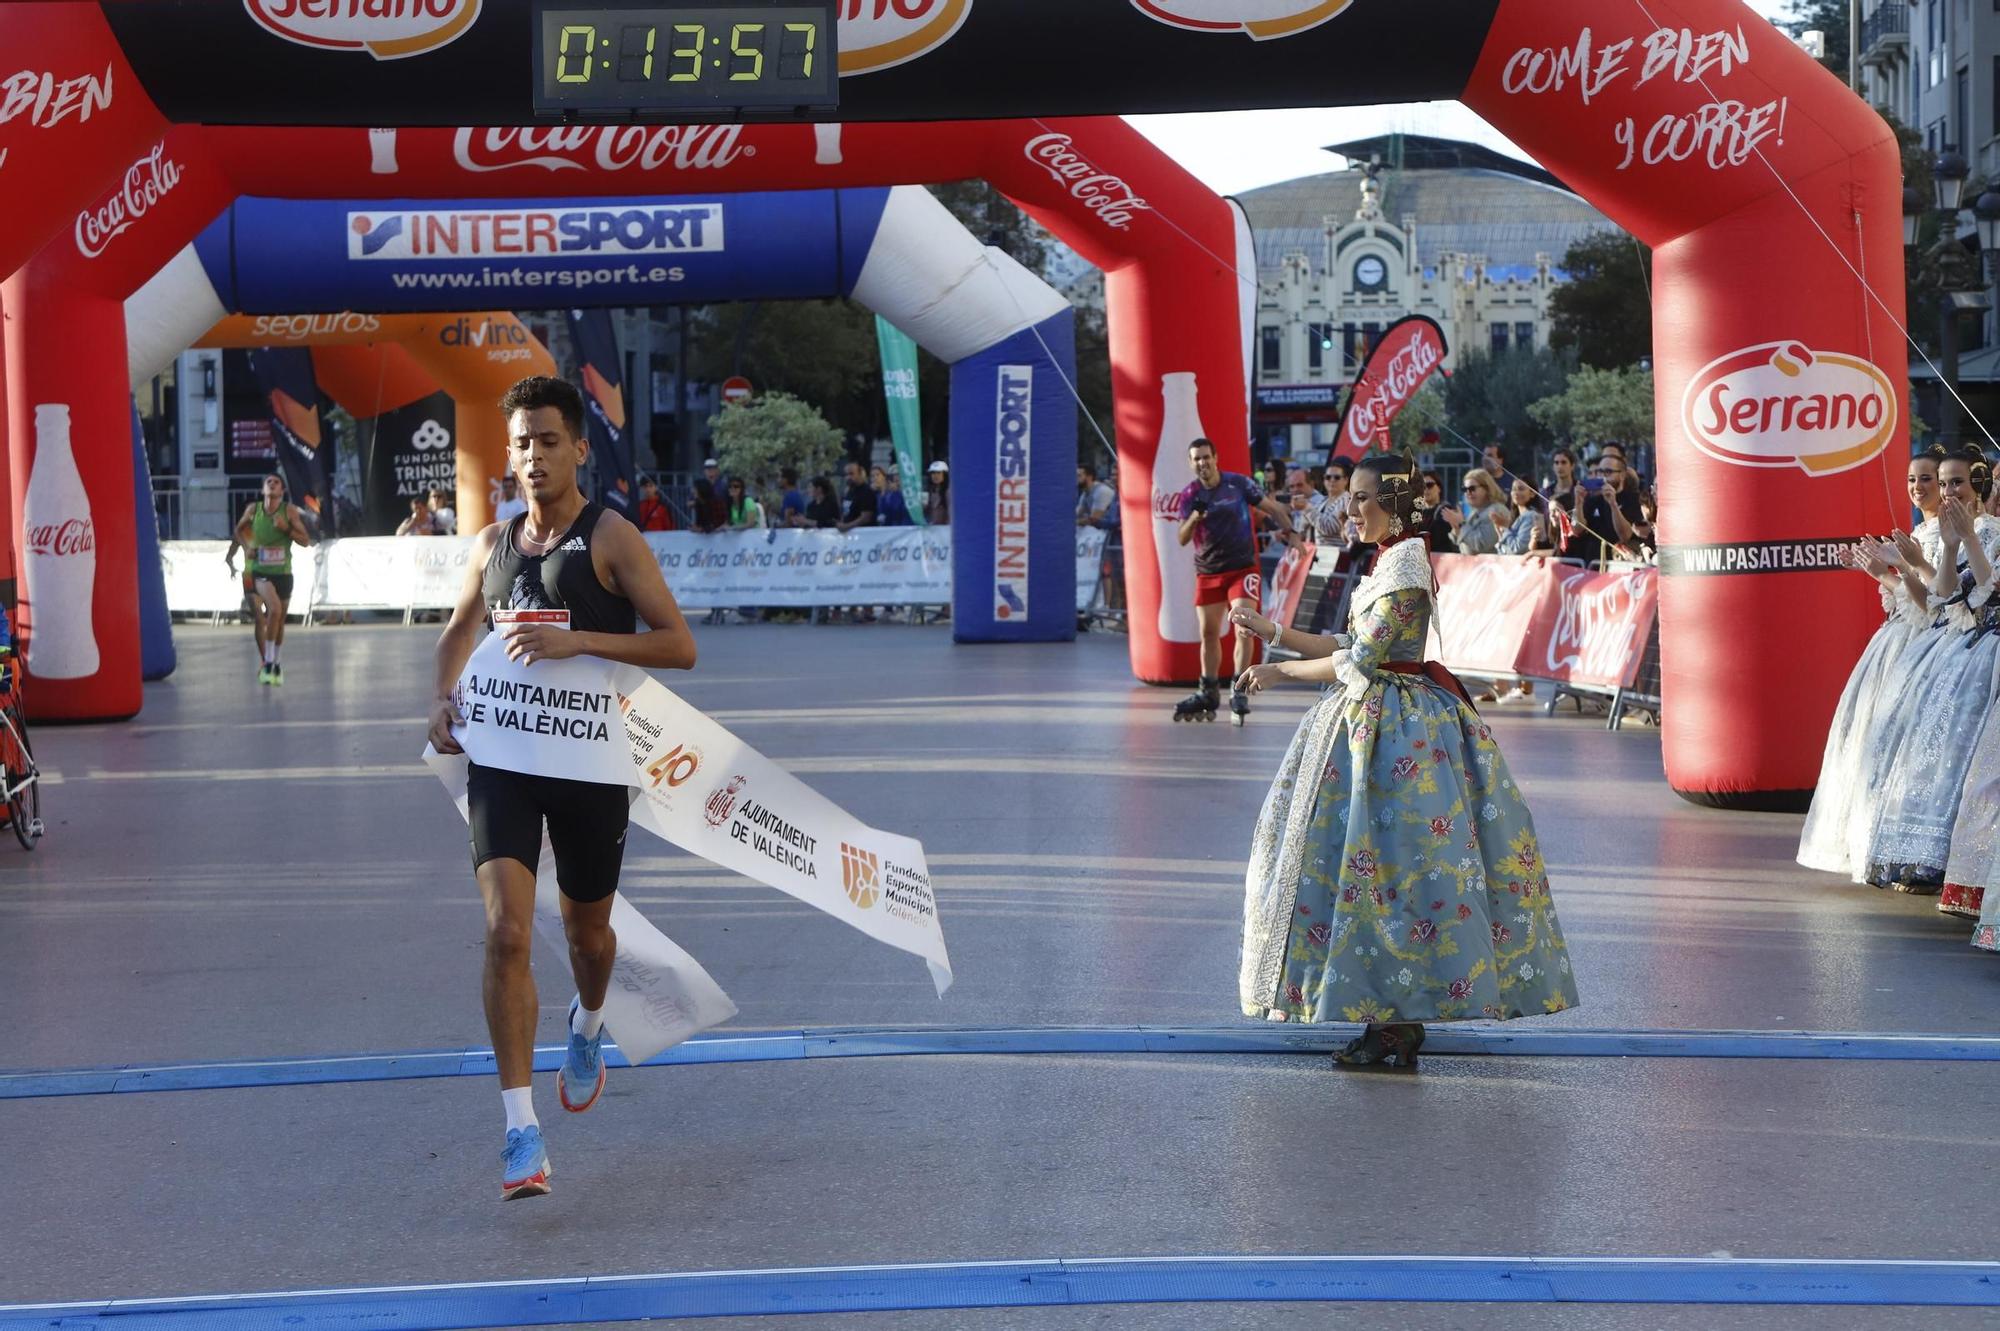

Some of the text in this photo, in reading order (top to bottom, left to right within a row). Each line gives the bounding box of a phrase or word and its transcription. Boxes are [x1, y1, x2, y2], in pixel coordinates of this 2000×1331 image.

[556, 24, 816, 82] 0:13:57
[1502, 22, 1750, 105] COME BIEN
[0, 61, 113, 128] BIEN
[453, 126, 744, 172] CocaCola
[1642, 97, 1788, 170] CORRE!
[75, 139, 180, 258] Coca-Cola
[1024, 133, 1152, 228] Coca-Cola
[412, 208, 711, 255] INTERSPORT
[392, 264, 686, 288] www.intersport.es
[252, 312, 381, 339] seguros
[440, 317, 528, 347] divina
[1703, 383, 1883, 436] Serrano
[997, 374, 1029, 579] INTERSPORT
[467, 674, 612, 714] AJUNTAMENT
[494, 707, 610, 742] VALÈNCIA
[626, 708, 664, 739] Fundació
[646, 743, 699, 787] 40
[731, 820, 817, 879] DE VALÈNCIA
[739, 799, 817, 855] AJUNTAMENT
[885, 874, 932, 902] Esportiva
[885, 888, 934, 917] Municipal
